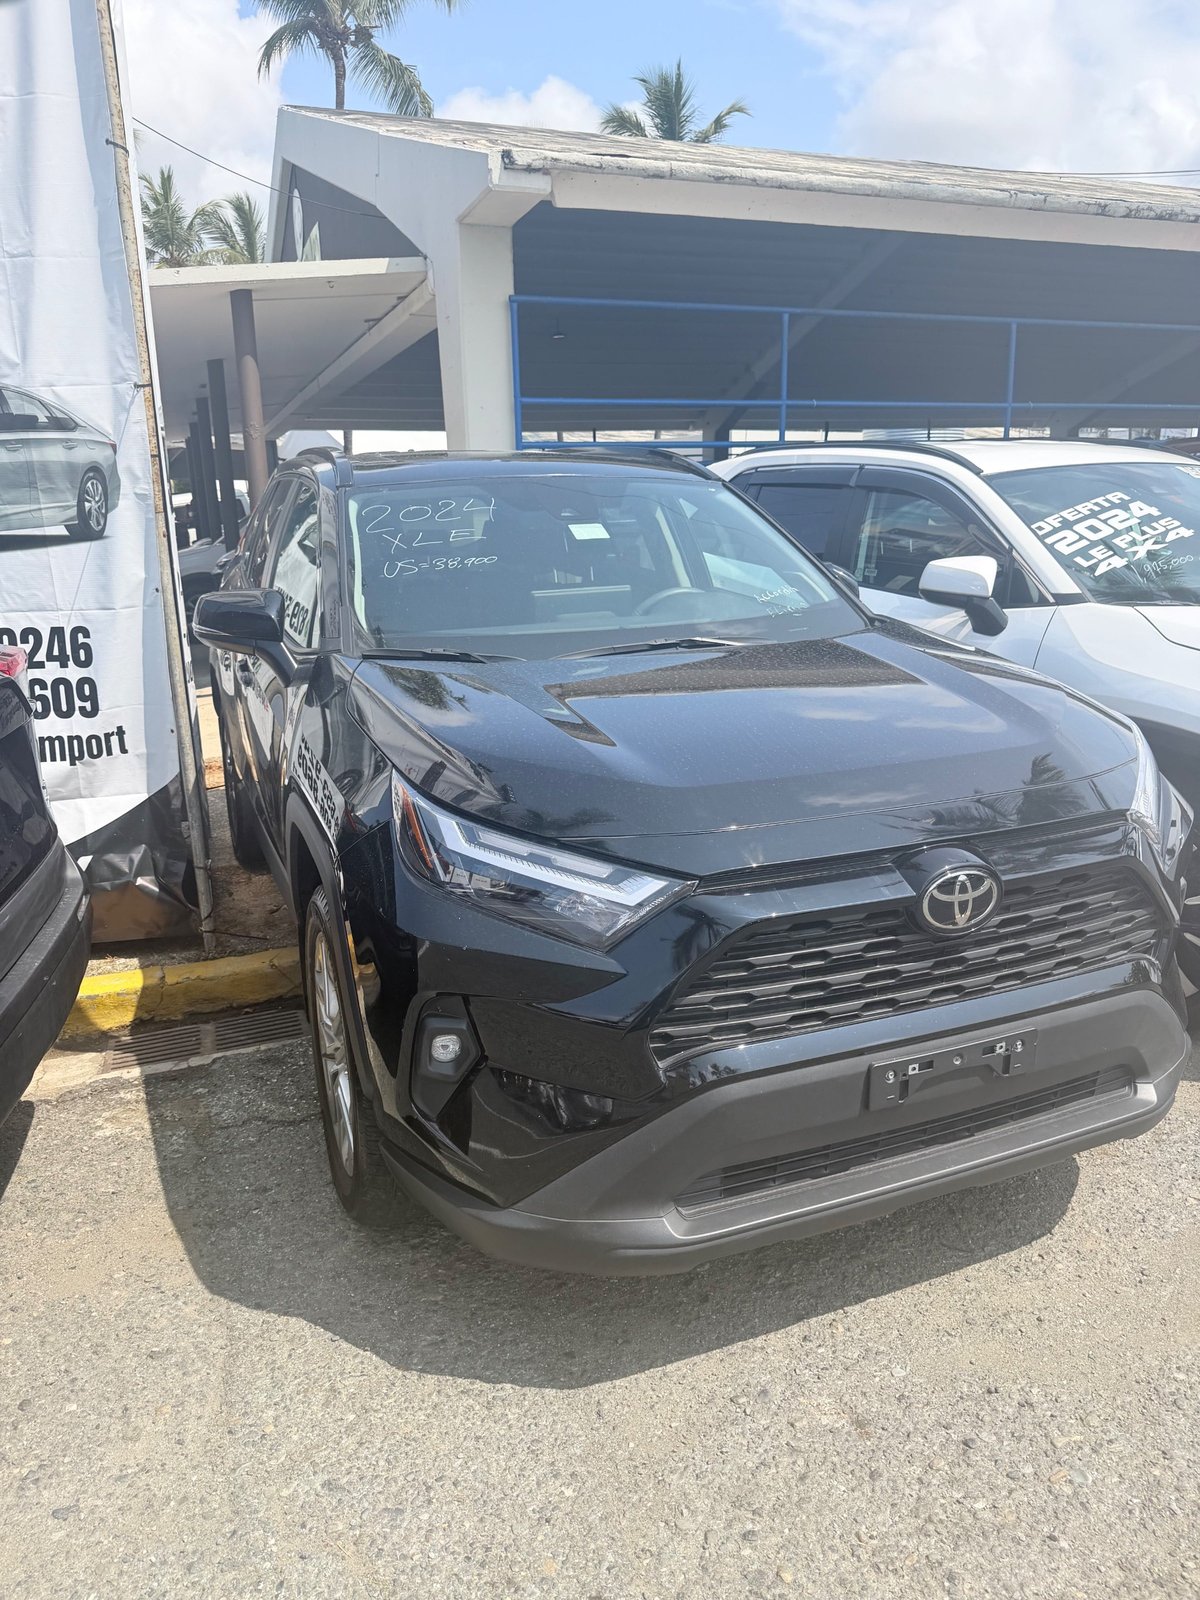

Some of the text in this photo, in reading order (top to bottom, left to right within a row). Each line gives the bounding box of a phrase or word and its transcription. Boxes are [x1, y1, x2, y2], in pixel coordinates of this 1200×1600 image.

[361, 497, 497, 534] 2024
[1030, 491, 1131, 536] OFERTA
[1044, 500, 1162, 556] 2024
[382, 529, 487, 554] XLE
[1073, 516, 1182, 568] LE PLUS
